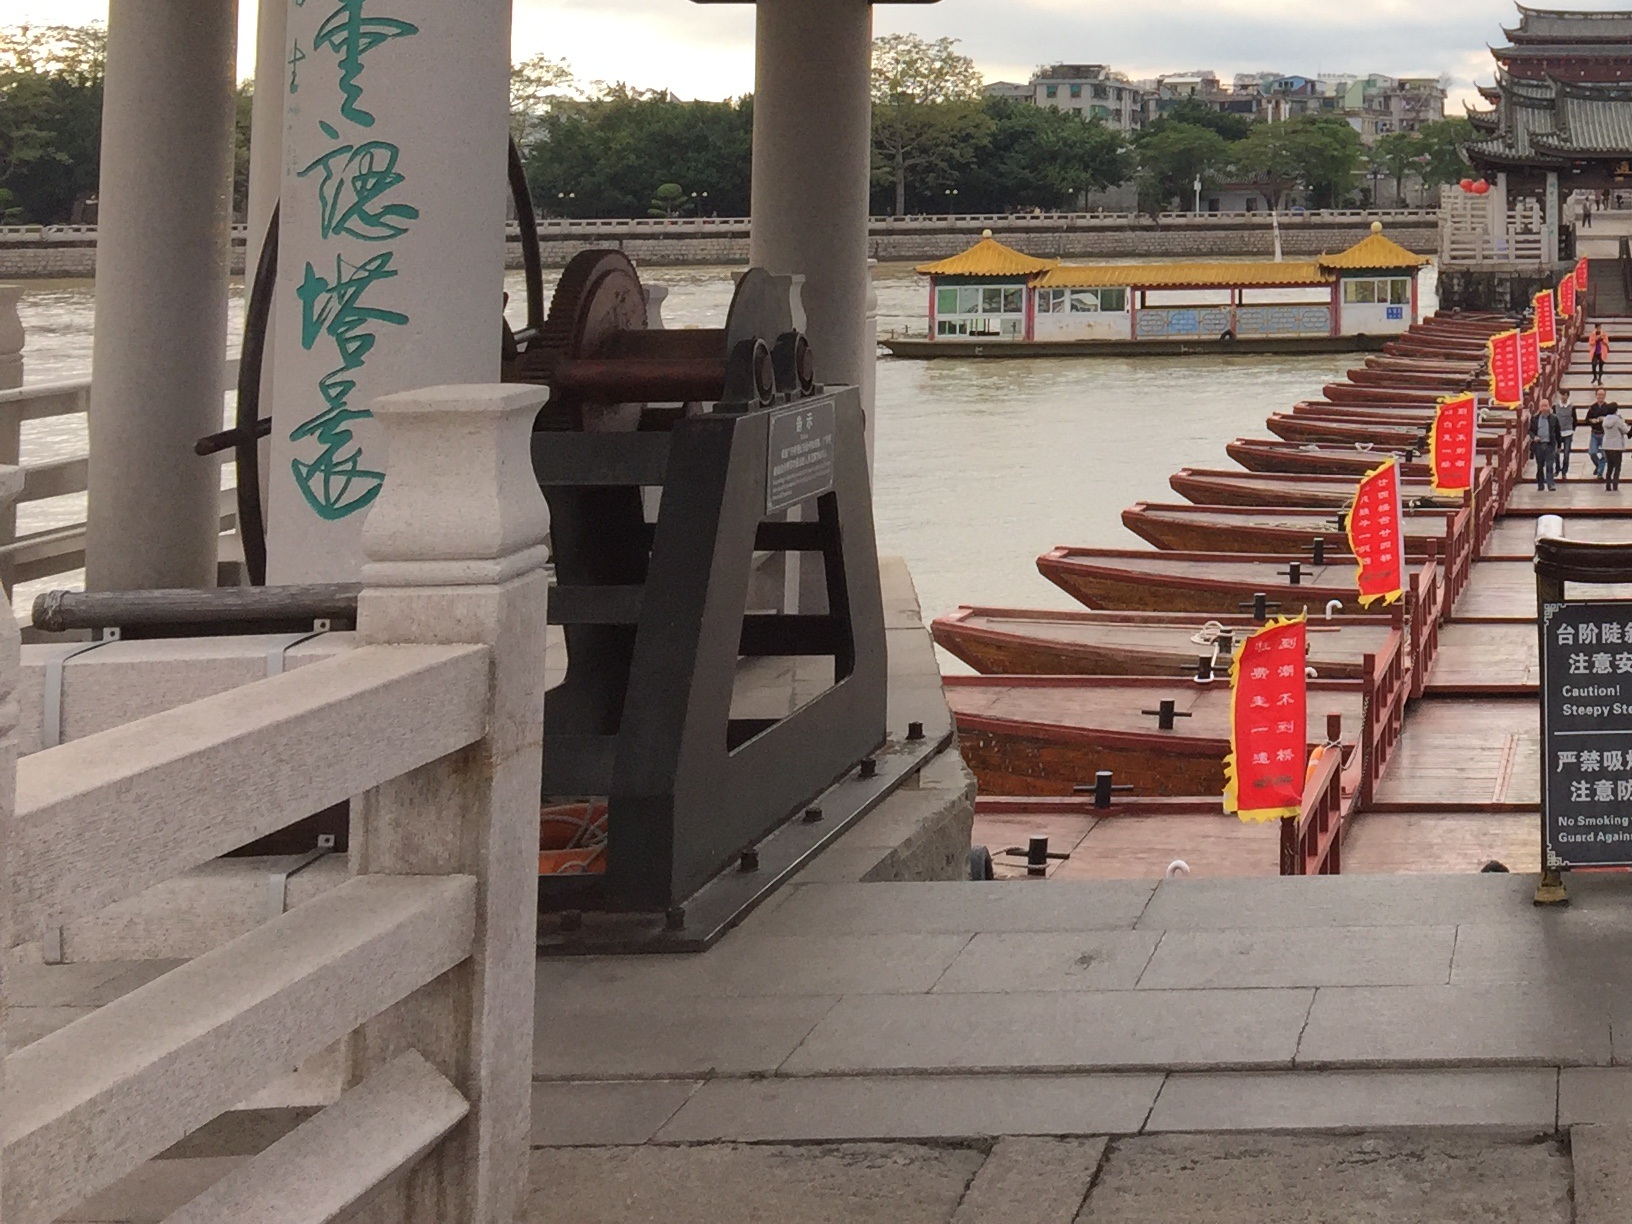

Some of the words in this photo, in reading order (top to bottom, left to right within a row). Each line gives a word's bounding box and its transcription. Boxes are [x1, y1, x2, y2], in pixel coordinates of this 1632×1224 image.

[1562, 684, 1621, 698] Caution!
[1562, 703, 1610, 717] Steepy
[1558, 816, 1575, 827] No
[1577, 815, 1629, 828] Smoking
[1558, 831, 1595, 843] Guard
